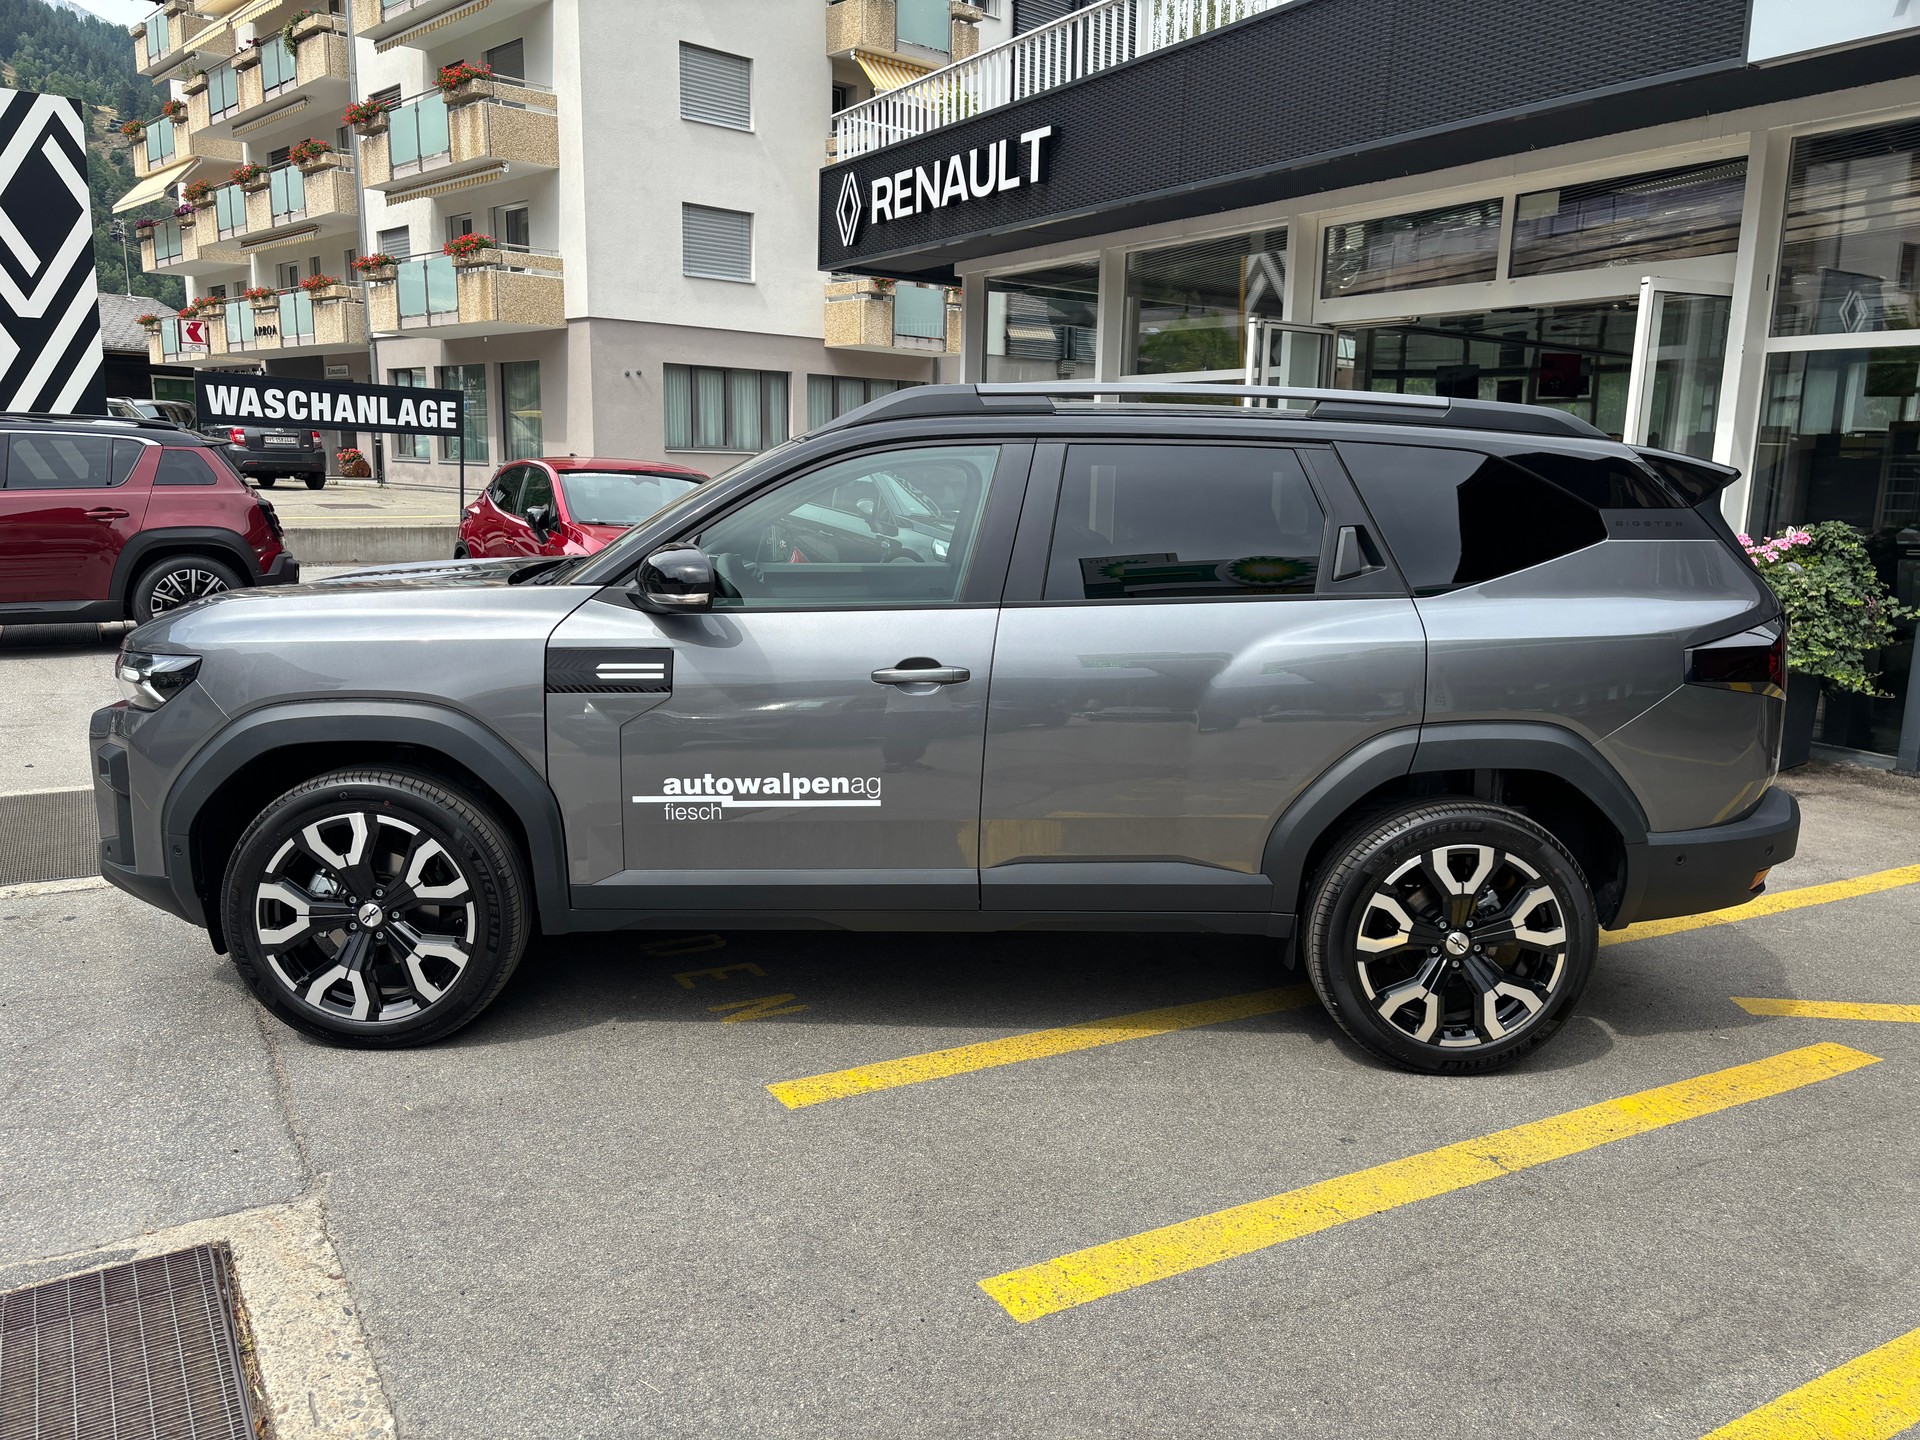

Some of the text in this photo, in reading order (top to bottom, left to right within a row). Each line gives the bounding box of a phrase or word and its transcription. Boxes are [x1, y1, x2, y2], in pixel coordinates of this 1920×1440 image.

[871, 125, 1052, 224] RENAULT
[205, 384, 457, 429] WASCHANLAGE
[664, 803, 723, 820] fiesch
[1391, 821, 1489, 852] MICHELIN
